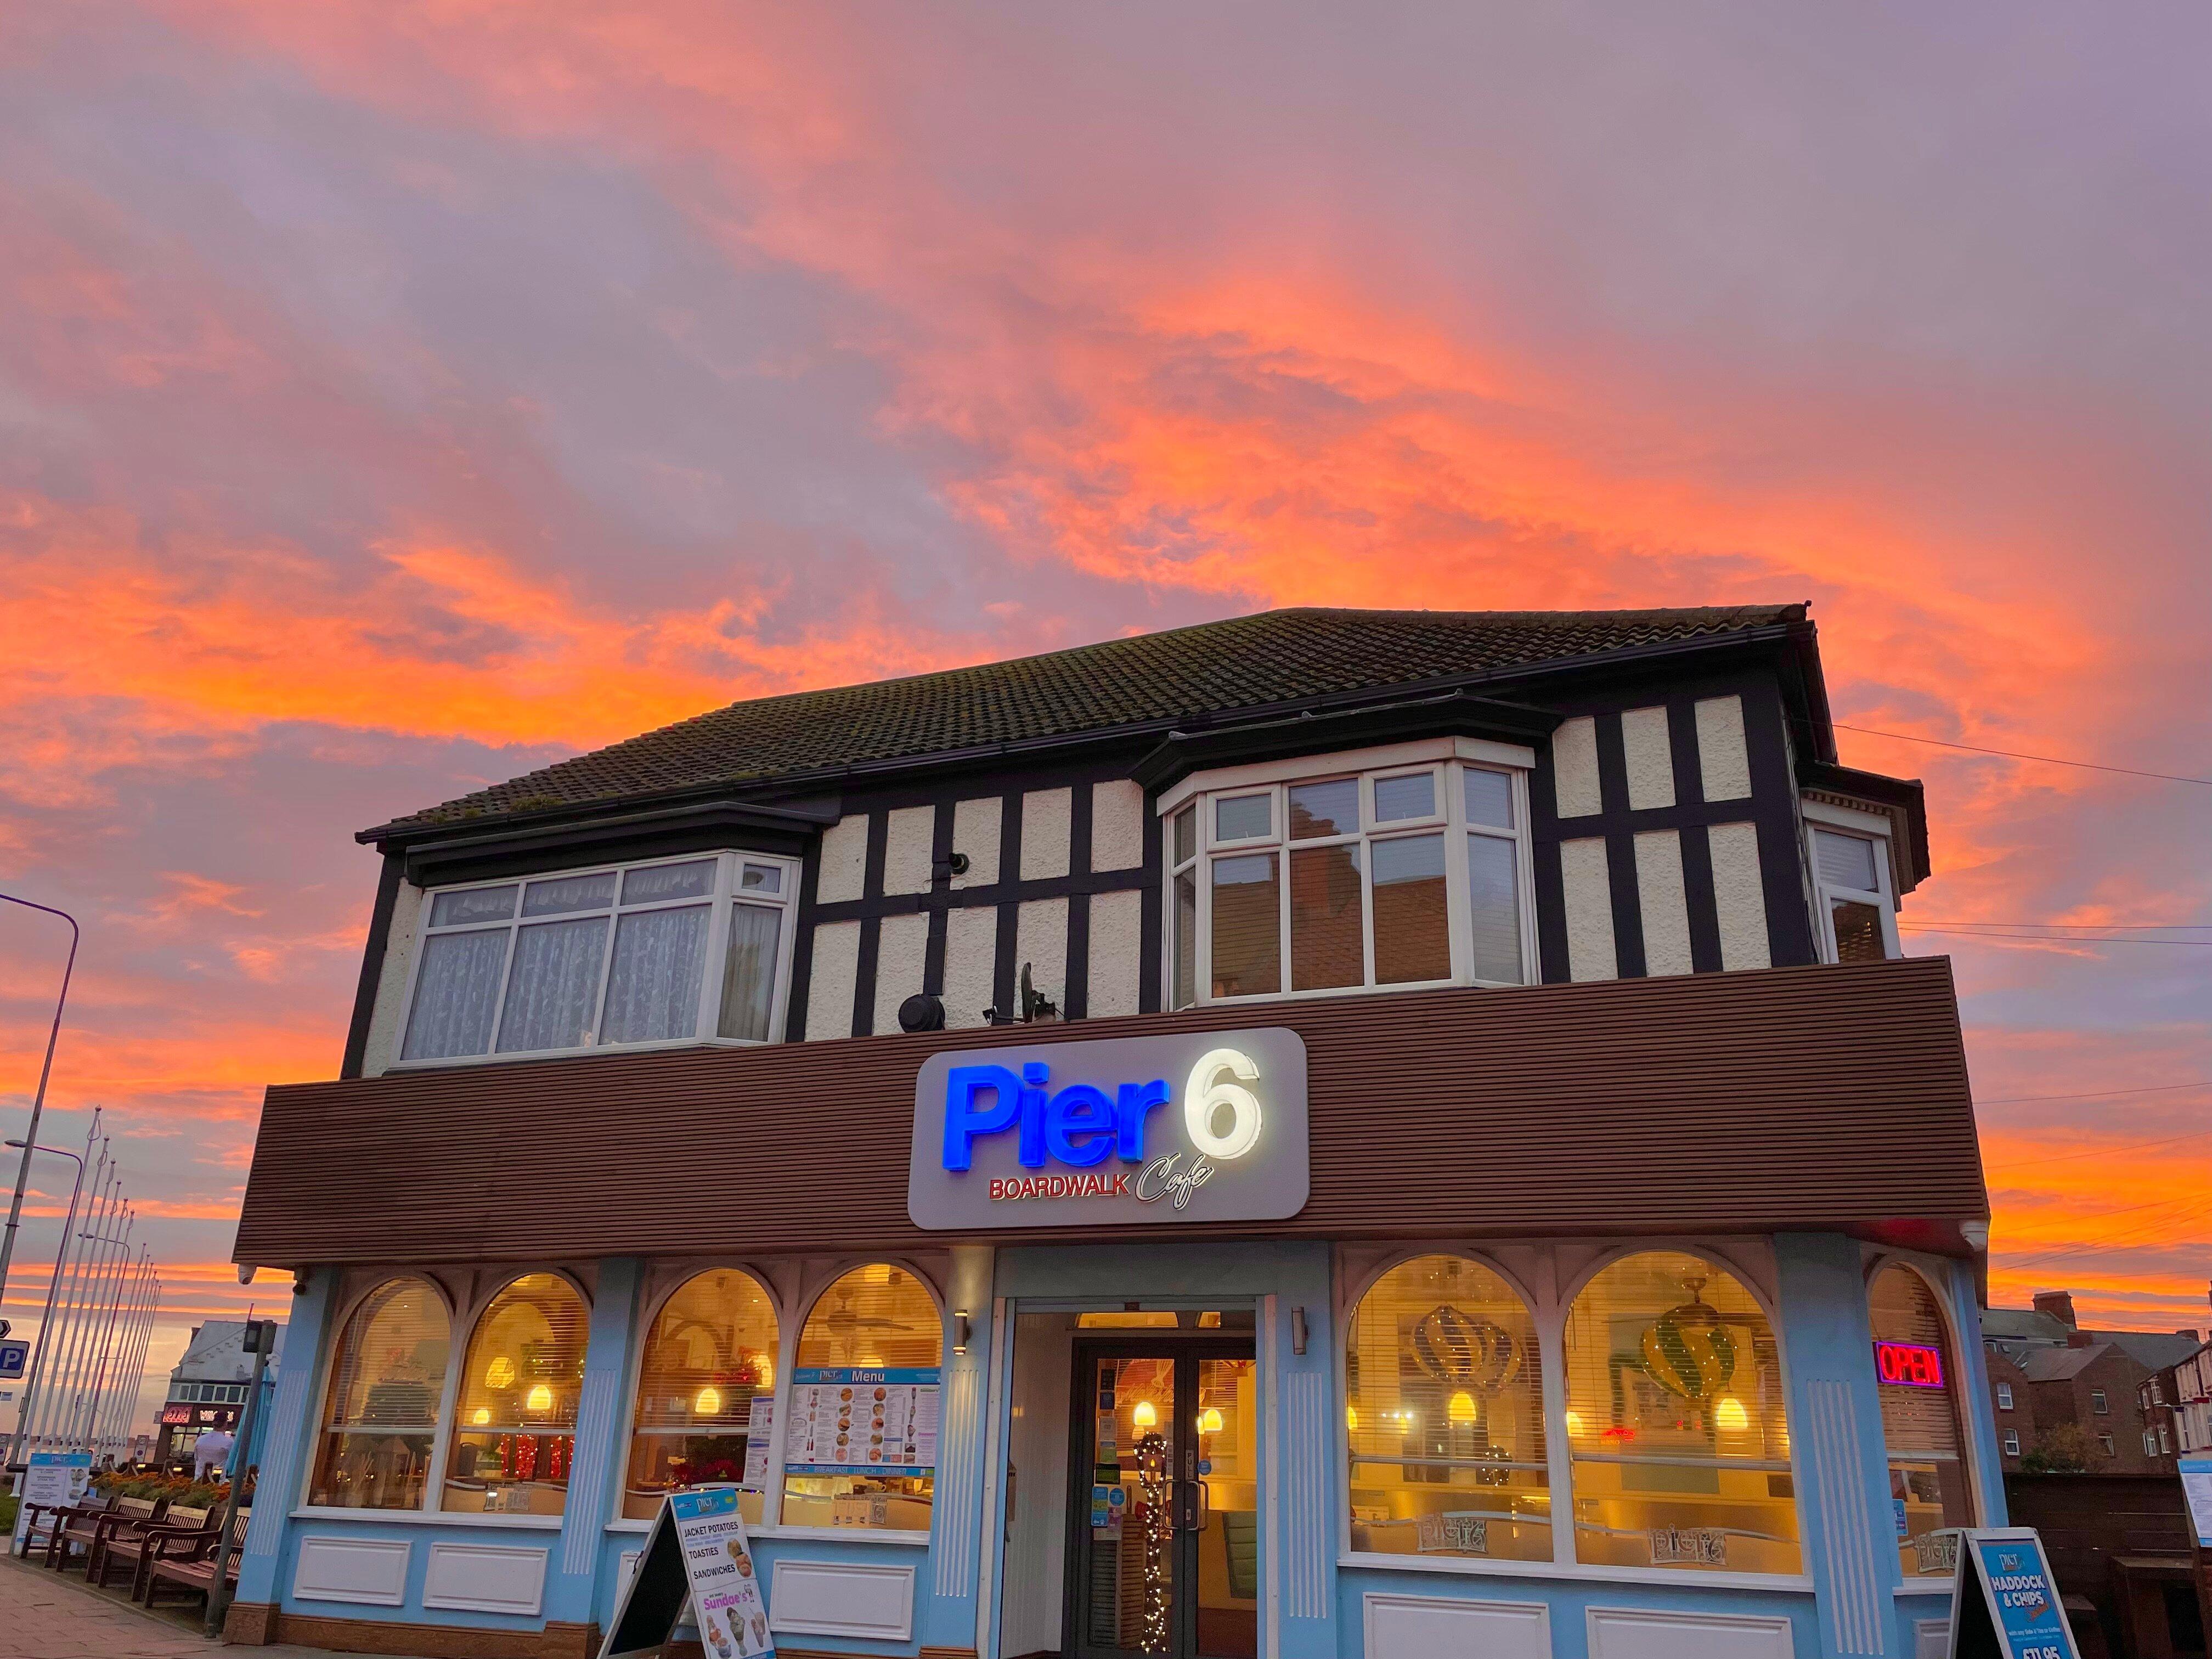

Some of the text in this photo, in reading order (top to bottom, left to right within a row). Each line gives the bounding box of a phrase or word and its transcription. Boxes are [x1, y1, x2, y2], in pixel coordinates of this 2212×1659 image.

[943, 1048, 1262, 1171] Pier 6
[990, 1153, 1214, 1210] BOARDWALK Cafe
[3, 1350, 20, 1368] P
[1880, 1345, 1940, 1383] OPEN
[852, 1371, 884, 1382] Menu
[882, 1467, 906, 1475] DINNER
[685, 1526, 706, 1537] JACKET
[709, 1522, 738, 1534] POTATOES
[689, 1547, 719, 1560] TOASTIES
[693, 1564, 736, 1579] SANDWICHES
[1991, 1575, 2045, 1590] HADDOCK
[704, 1592, 747, 1610] Sundae's
[2004, 1592, 2044, 1607] & CHIPS
[2023, 1646, 2061, 1659] £1195
